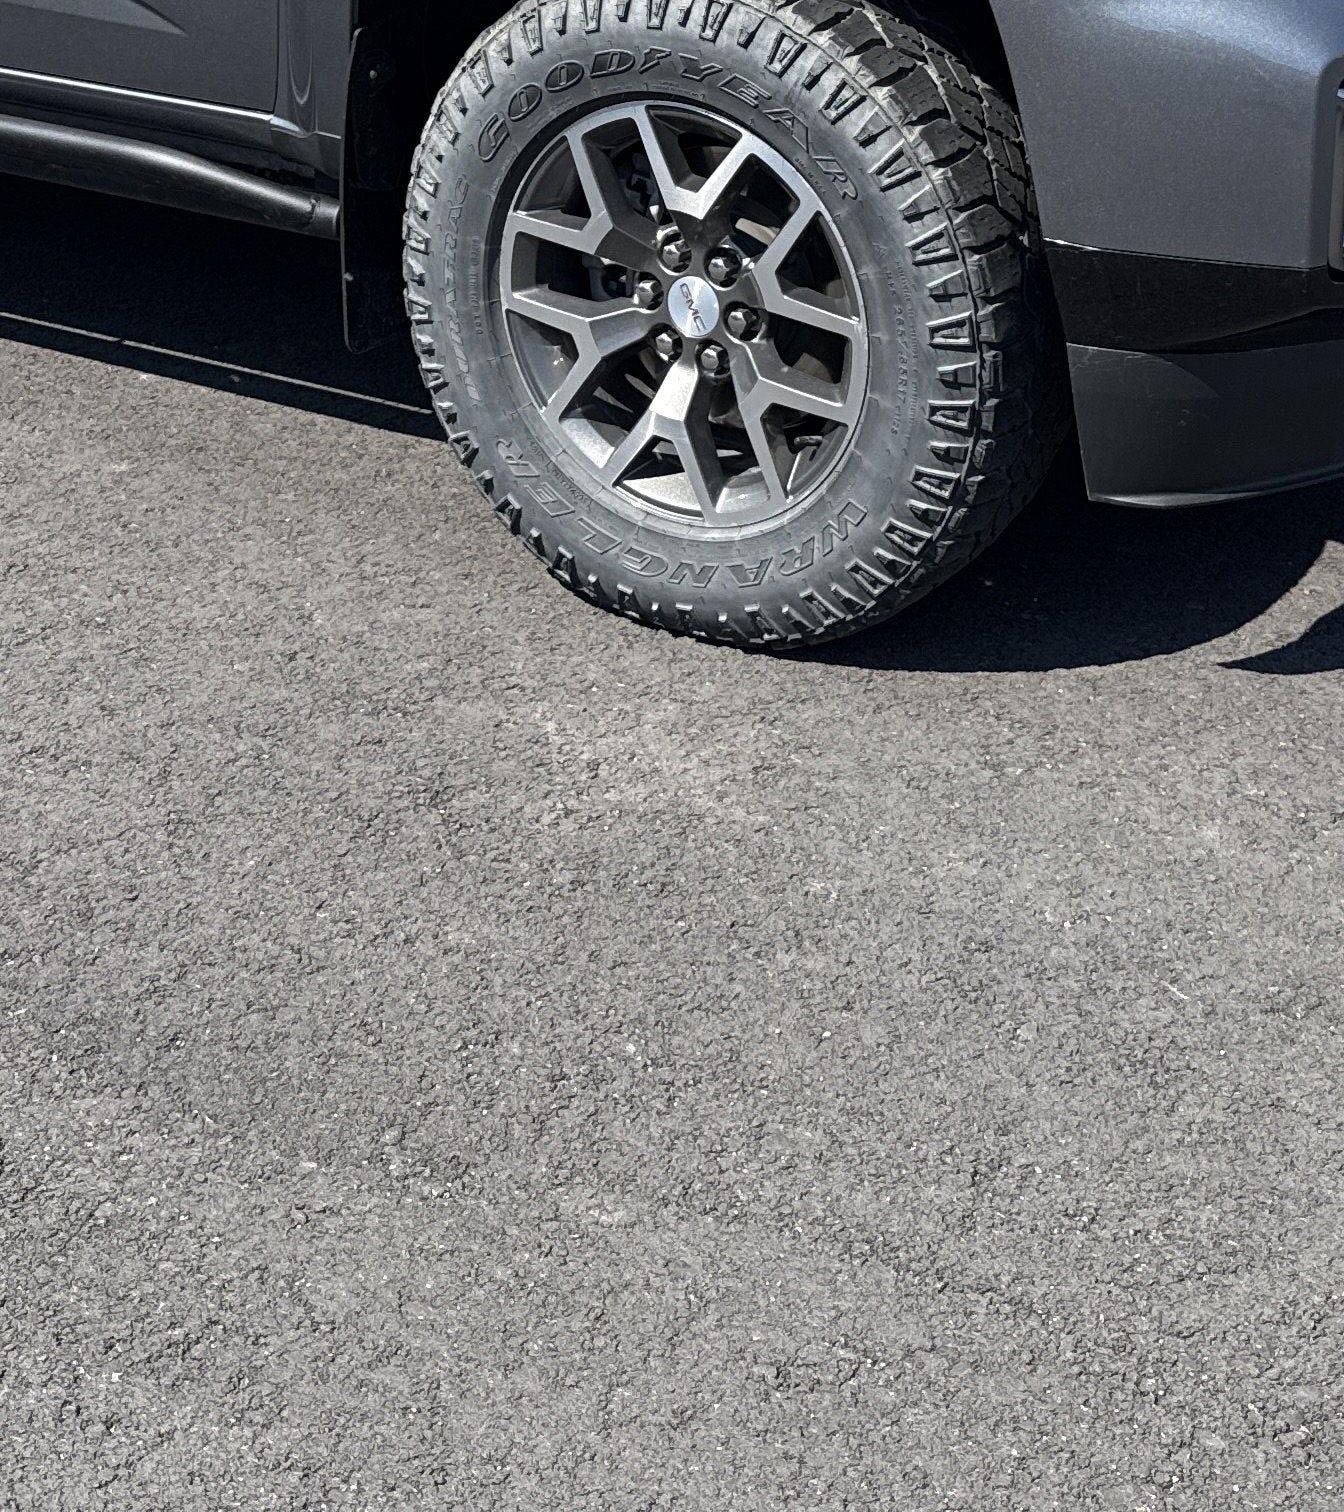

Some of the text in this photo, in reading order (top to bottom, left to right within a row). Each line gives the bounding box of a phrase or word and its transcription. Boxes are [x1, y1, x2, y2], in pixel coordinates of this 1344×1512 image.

[478, 45, 858, 200] GOODYEAR
[679, 283, 708, 332] GMC
[496, 438, 868, 588] WRANGLER
